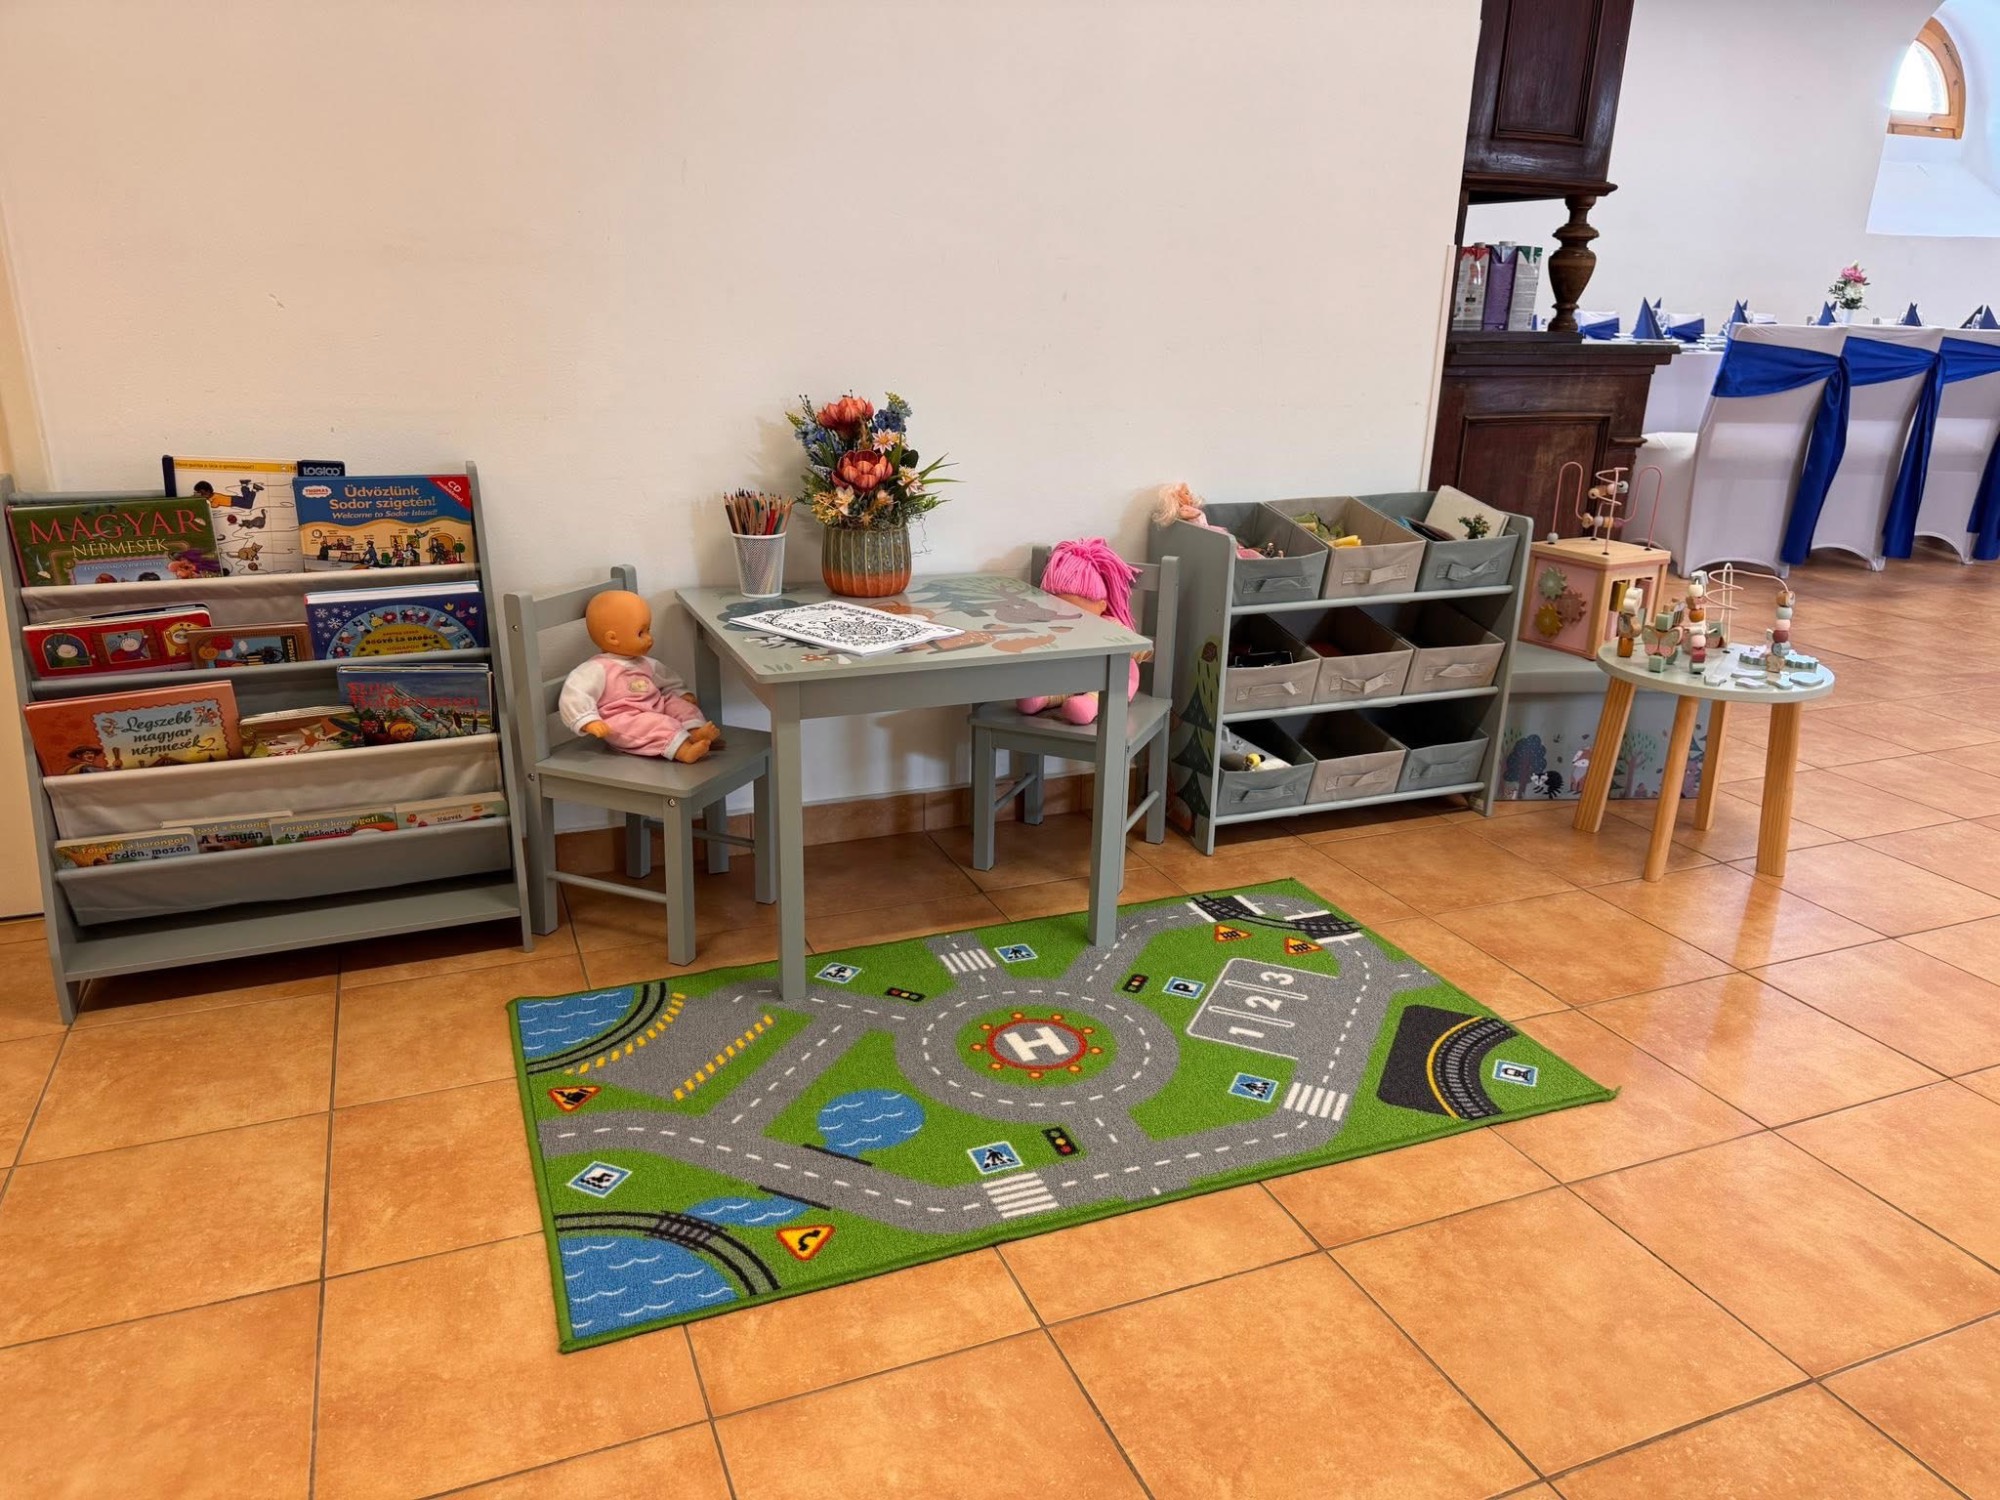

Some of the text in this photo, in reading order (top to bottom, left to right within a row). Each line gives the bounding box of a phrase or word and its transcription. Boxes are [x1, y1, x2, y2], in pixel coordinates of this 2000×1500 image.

[344, 484, 419, 498] Üdvözlünk
[448, 480, 462, 493] CD
[330, 496, 437, 511] Sodor szigetén!
[332, 511, 373, 520] Welcome
[385, 510, 410, 518] Sodor
[29, 508, 204, 545] MAGYAR
[71, 536, 170, 558] NÉPMESÉK
[121, 710, 193, 733] Legszebb
[134, 728, 193, 744] magyar
[131, 735, 202, 757] népmesék
[330, 815, 379, 828] korongot!
[200, 830, 264, 844] A tanyán
[284, 832, 296, 840] Az
[135, 836, 189, 852] korongot!
[151, 843, 191, 856] mezőn
[1260, 970, 1295, 986] 3
[1172, 981, 1194, 994] P
[1244, 995, 1284, 1013] 2
[1228, 1025, 1265, 1039] 1
[1003, 1025, 1070, 1062] H
